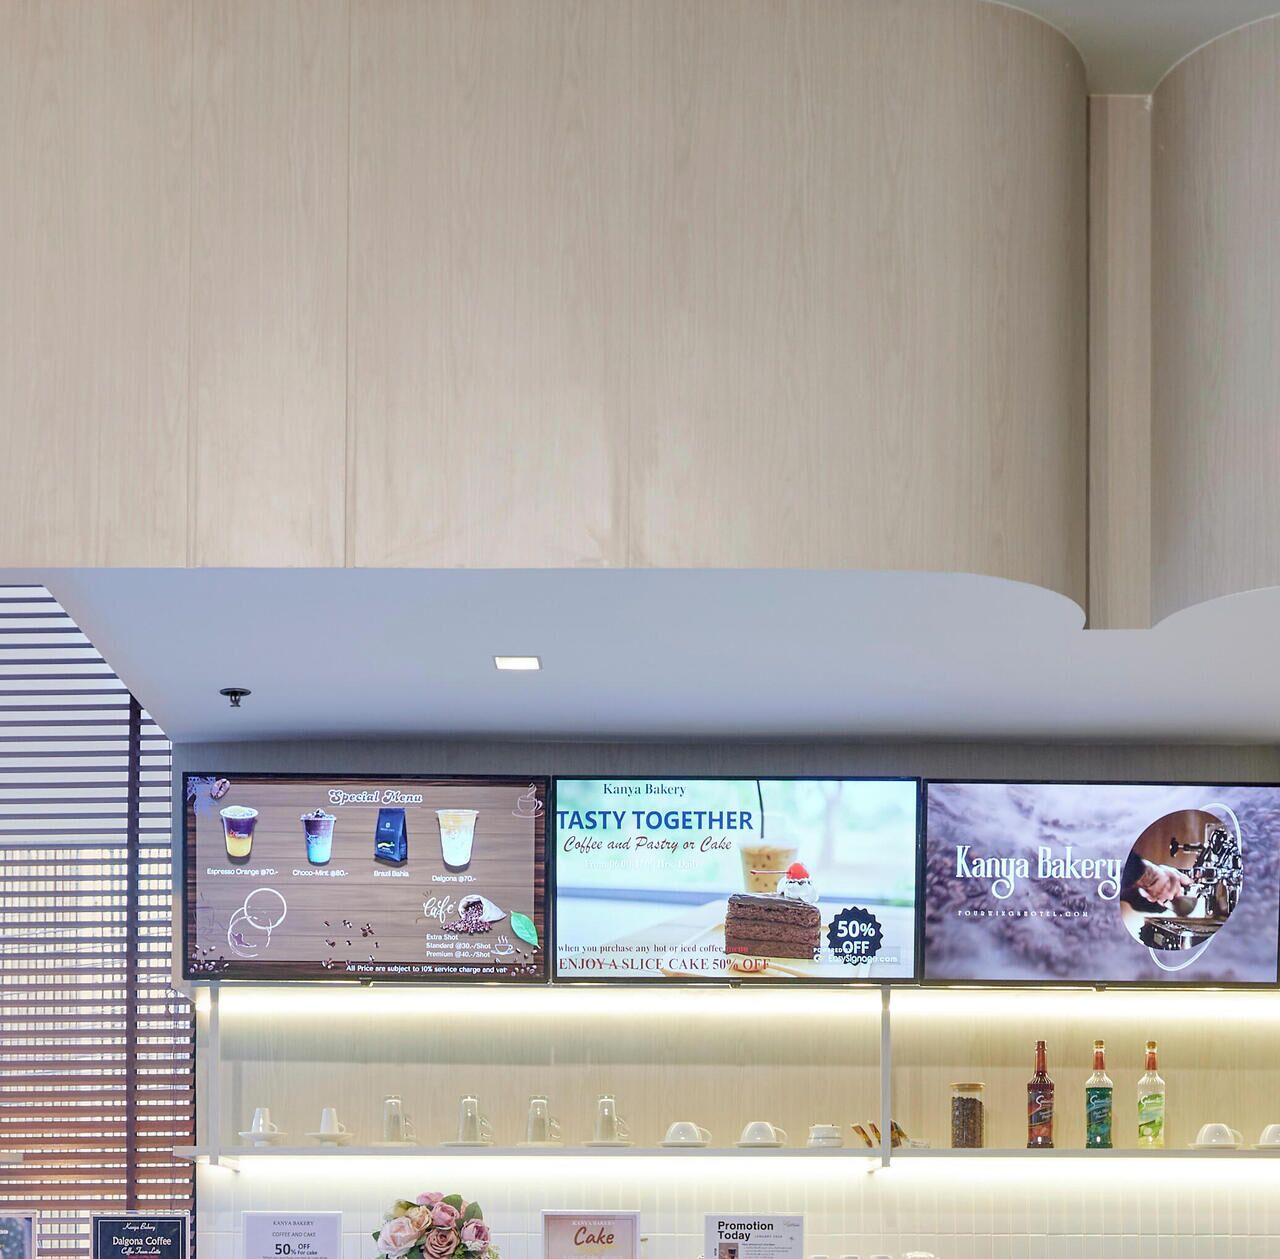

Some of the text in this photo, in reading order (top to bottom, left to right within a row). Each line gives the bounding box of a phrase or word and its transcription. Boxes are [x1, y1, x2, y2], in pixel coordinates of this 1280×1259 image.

[603, 784, 687, 797] Kanya Bakery
[328, 790, 423, 805] Special Menu
[557, 811, 754, 830] TASTY TOGETHER
[563, 836, 732, 854] Coffee and Pastry or Cake
[207, 868, 235, 877] Espresso
[236, 868, 259, 877] Orange
[956, 845, 1122, 900] Kanya Bakery
[423, 896, 457, 924] Café
[837, 920, 876, 938] 50%
[558, 944, 579, 953] when
[582, 946, 597, 955] you
[635, 946, 651, 955] any
[654, 944, 667, 953] hot
[680, 944, 696, 953] iced
[700, 944, 725, 953] coffee
[842, 941, 870, 954] OFF
[357, 964, 374, 972] Price
[387, 965, 410, 975] subject
[421, 965, 433, 973] 10%
[434, 966, 457, 974] service
[459, 966, 481, 976] charge
[482, 966, 495, 974] and
[559, 958, 771, 971] ENJOY A SLICE CAKE 50% OFF
[718, 1221, 774, 1231] Promotion
[112, 1237, 172, 1246] Dalgona Coffee
[574, 1226, 615, 1246] Cake
[717, 1231, 751, 1242] Today
[275, 1243, 297, 1256] 50%
